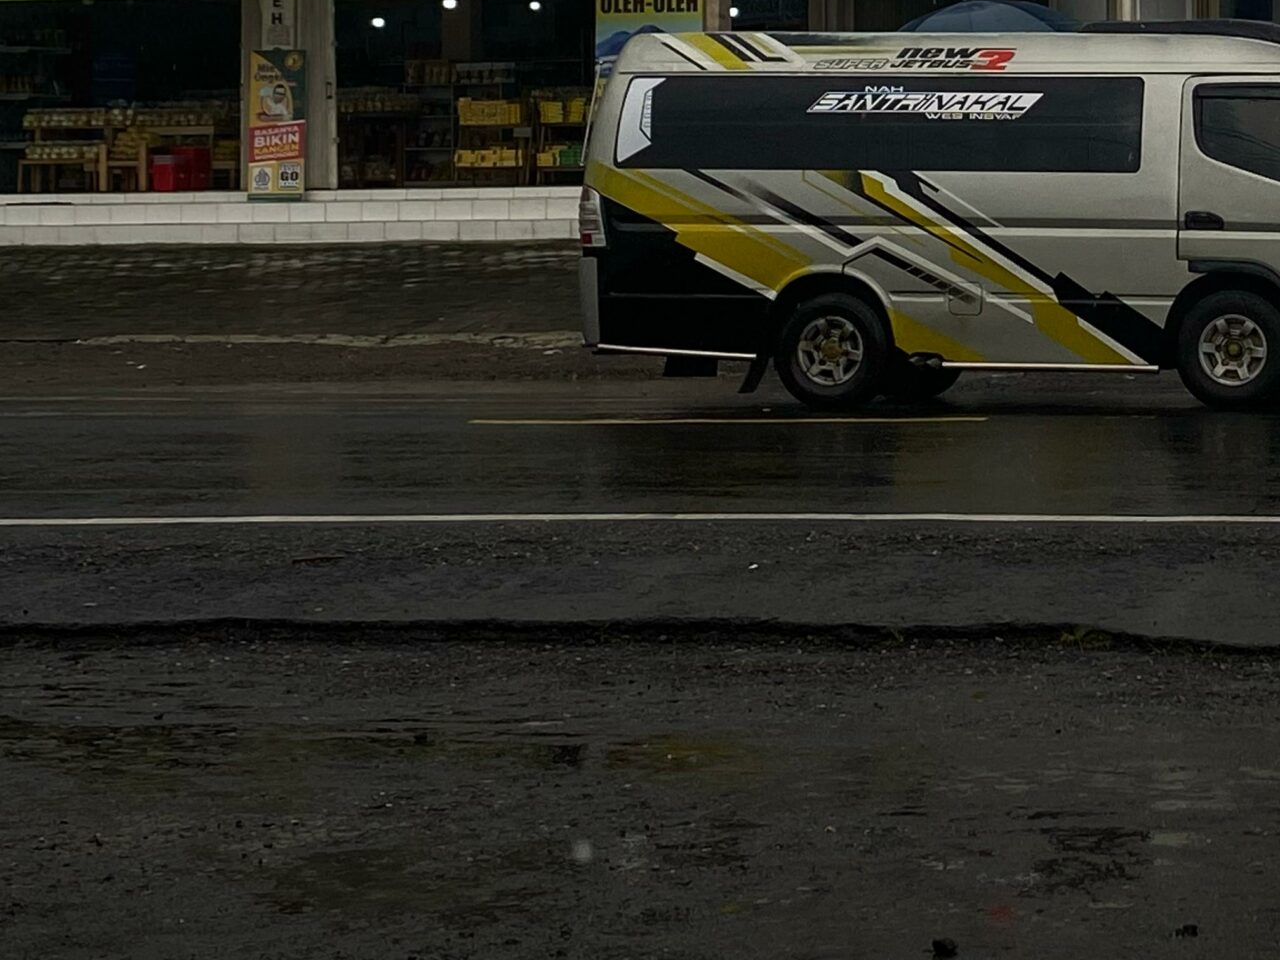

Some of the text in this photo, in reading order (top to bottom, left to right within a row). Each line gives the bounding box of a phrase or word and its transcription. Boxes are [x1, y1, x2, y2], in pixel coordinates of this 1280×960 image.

[896, 48, 978, 59] new
[813, 58, 889, 70] SUPER
[890, 58, 974, 69] JETBUS
[865, 85, 905, 93] NAH
[254, 132, 299, 147] BIKIN
